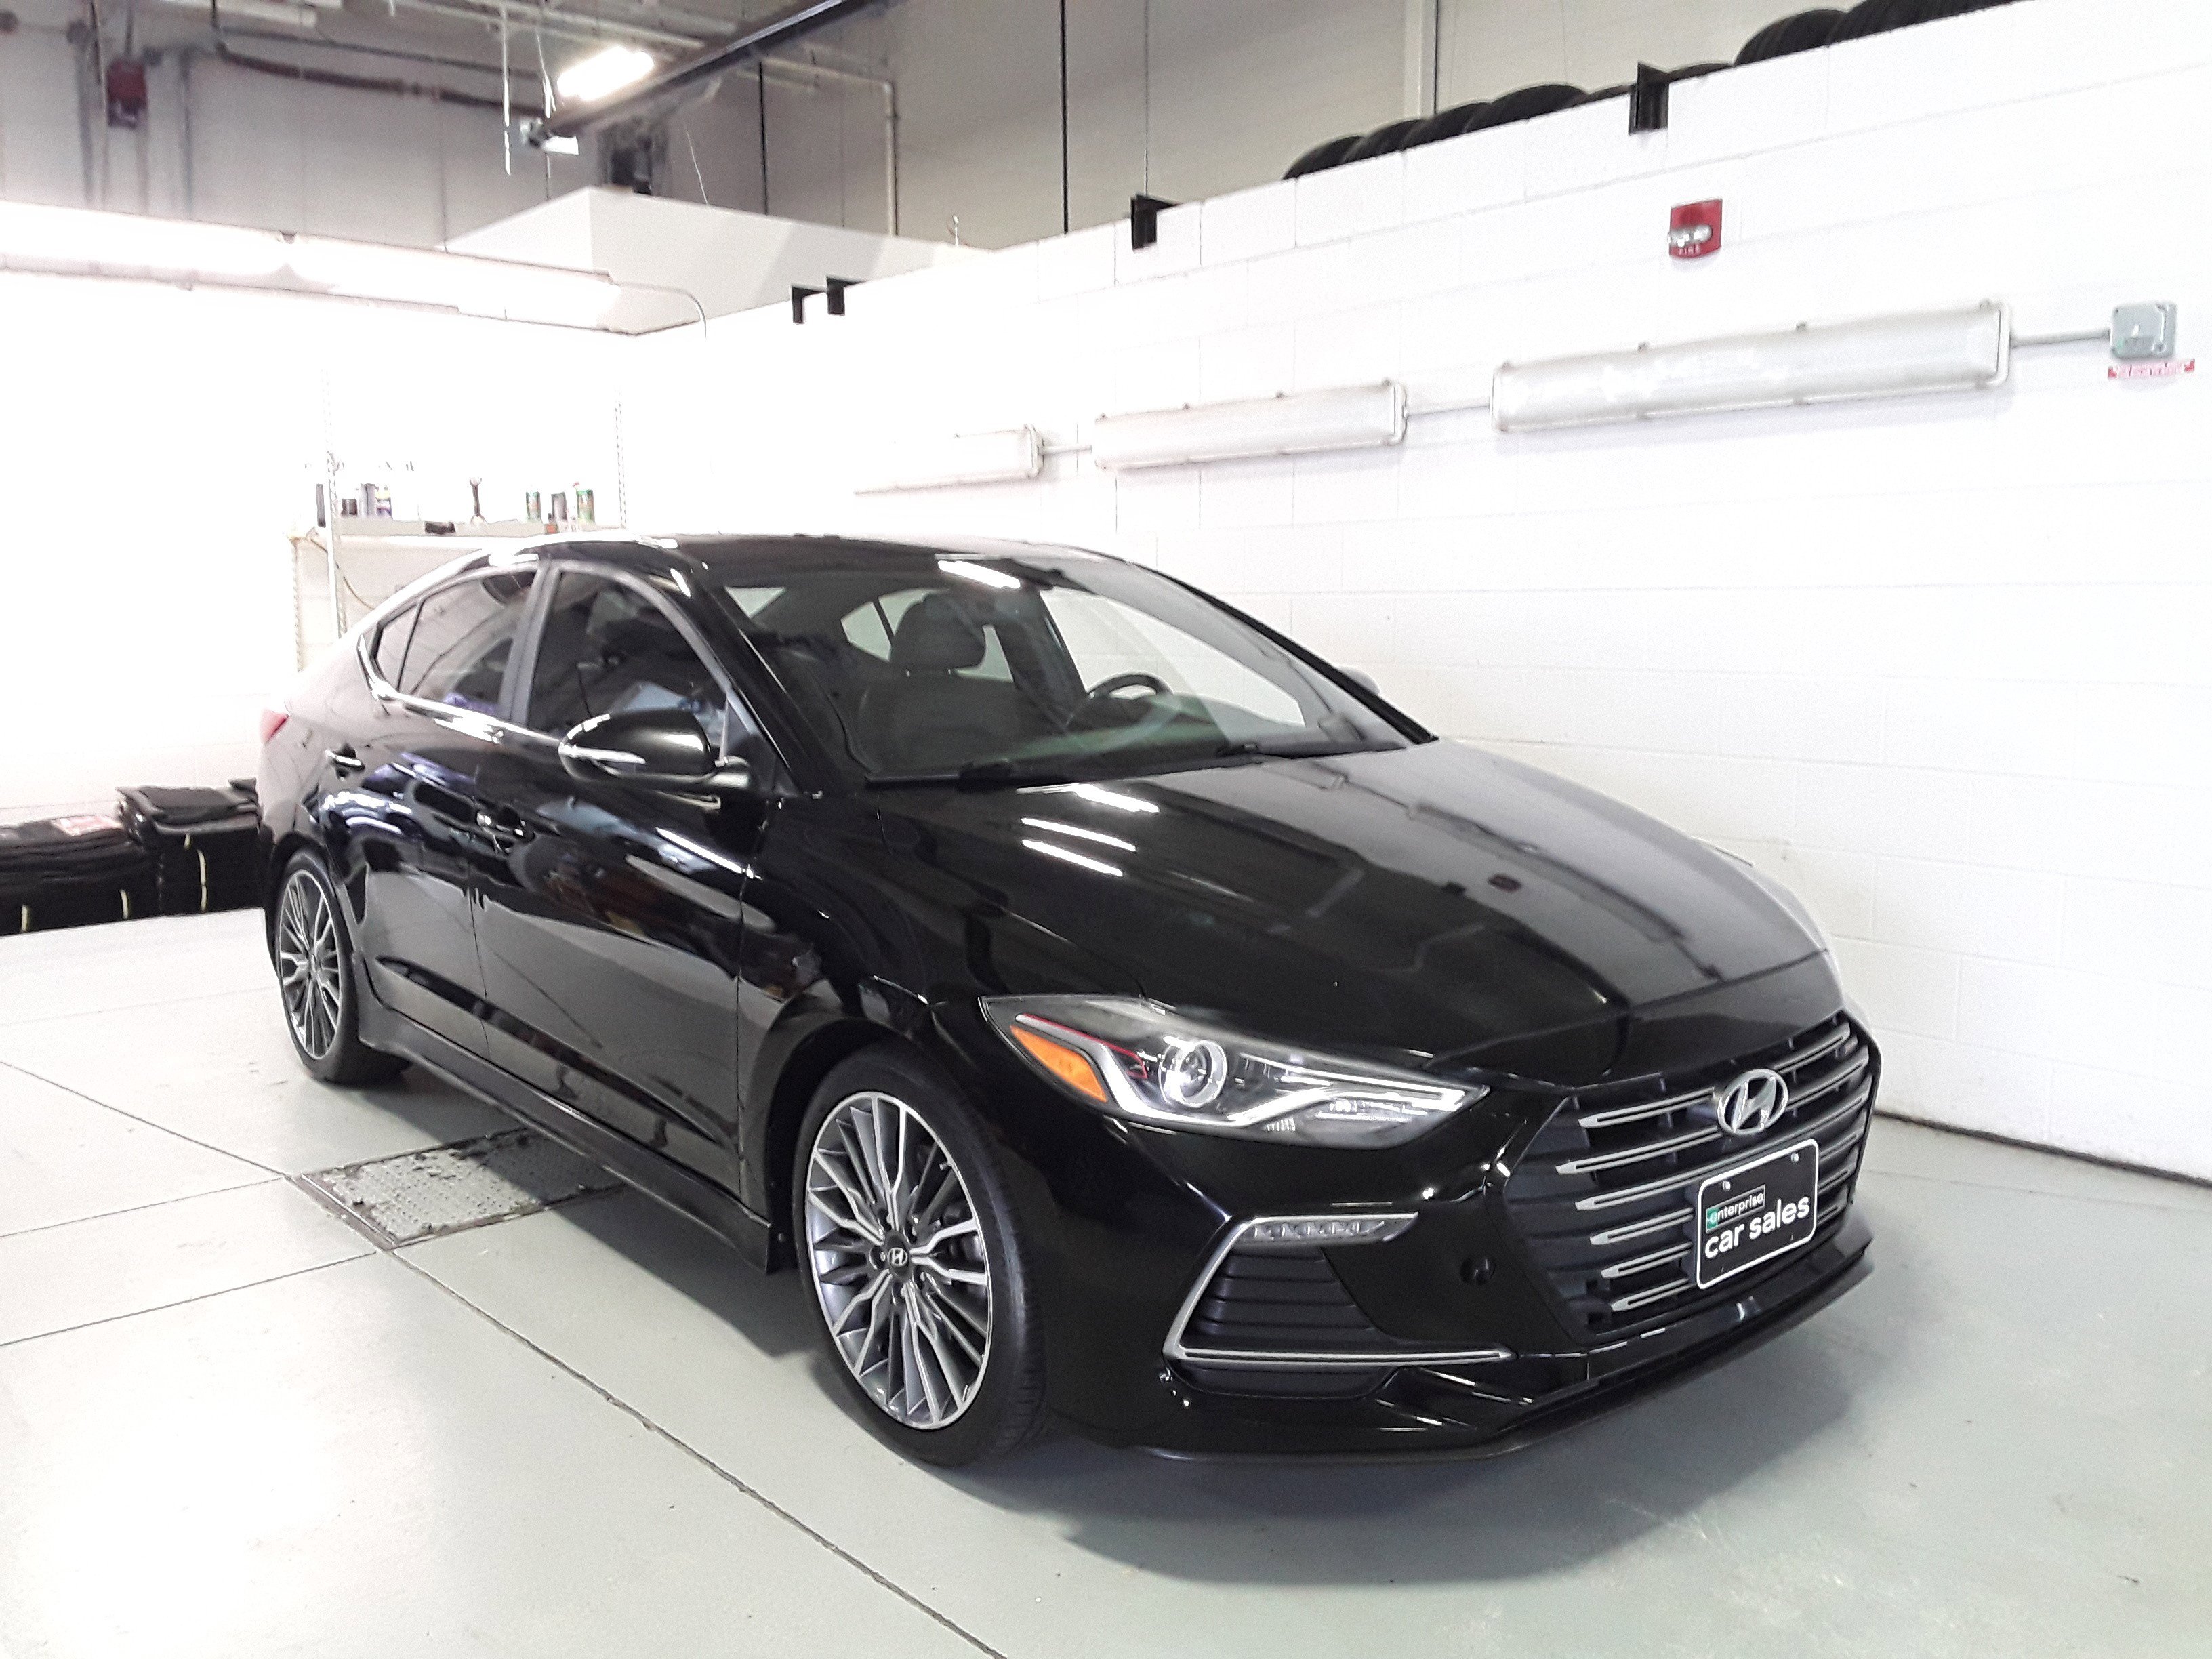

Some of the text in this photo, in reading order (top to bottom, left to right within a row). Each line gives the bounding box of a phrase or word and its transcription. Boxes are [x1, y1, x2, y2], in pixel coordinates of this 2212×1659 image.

[1704, 1197, 1810, 1258] car sales
[1707, 1193, 1764, 1224] enterprise
